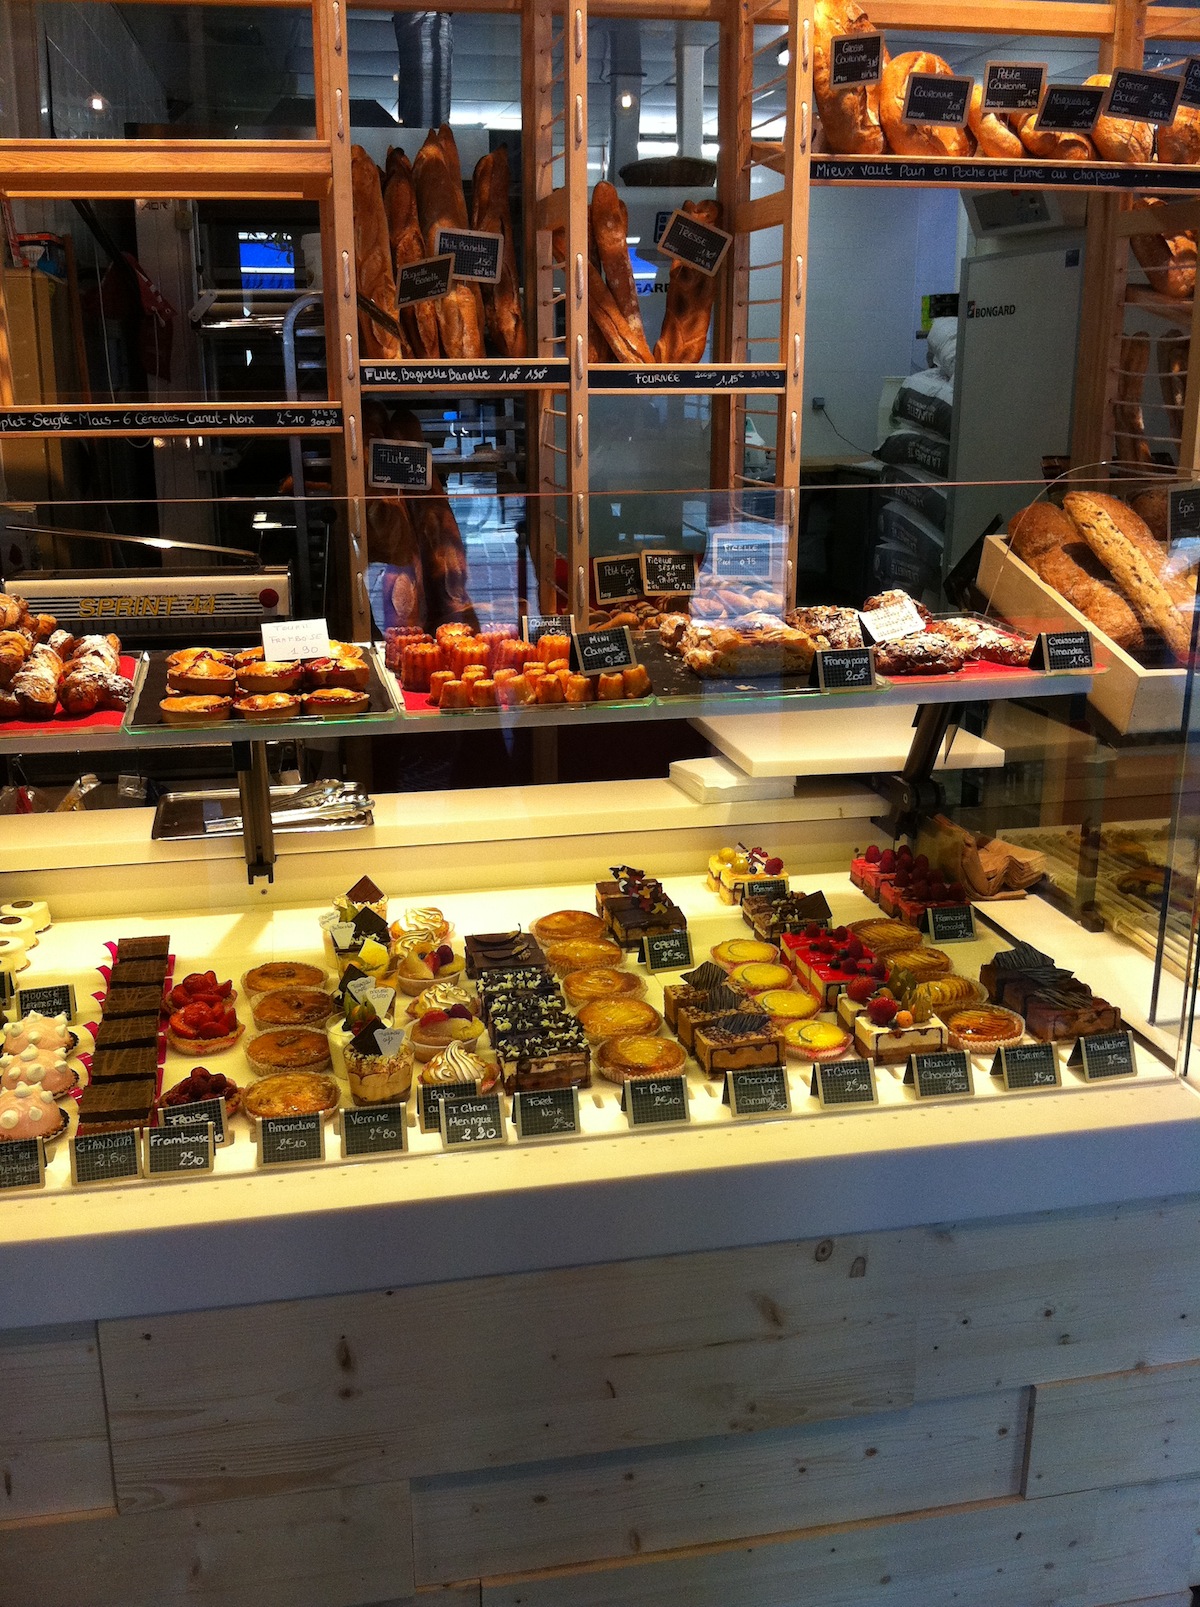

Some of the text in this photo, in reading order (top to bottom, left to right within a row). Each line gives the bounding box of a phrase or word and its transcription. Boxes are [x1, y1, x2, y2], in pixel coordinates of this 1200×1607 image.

[815, 162, 854, 178] Mieux
[860, 163, 893, 176] vaut
[900, 164, 926, 177] Pain
[933, 166, 948, 177] en
[1013, 167, 1046, 182] plume
[1051, 170, 1068, 180] au
[1073, 169, 1121, 186] chapeau
[976, 304, 1016, 318] BONGARD
[79, 595, 216, 618] SPRINT 44
[350, 1111, 390, 1125] Verrine
